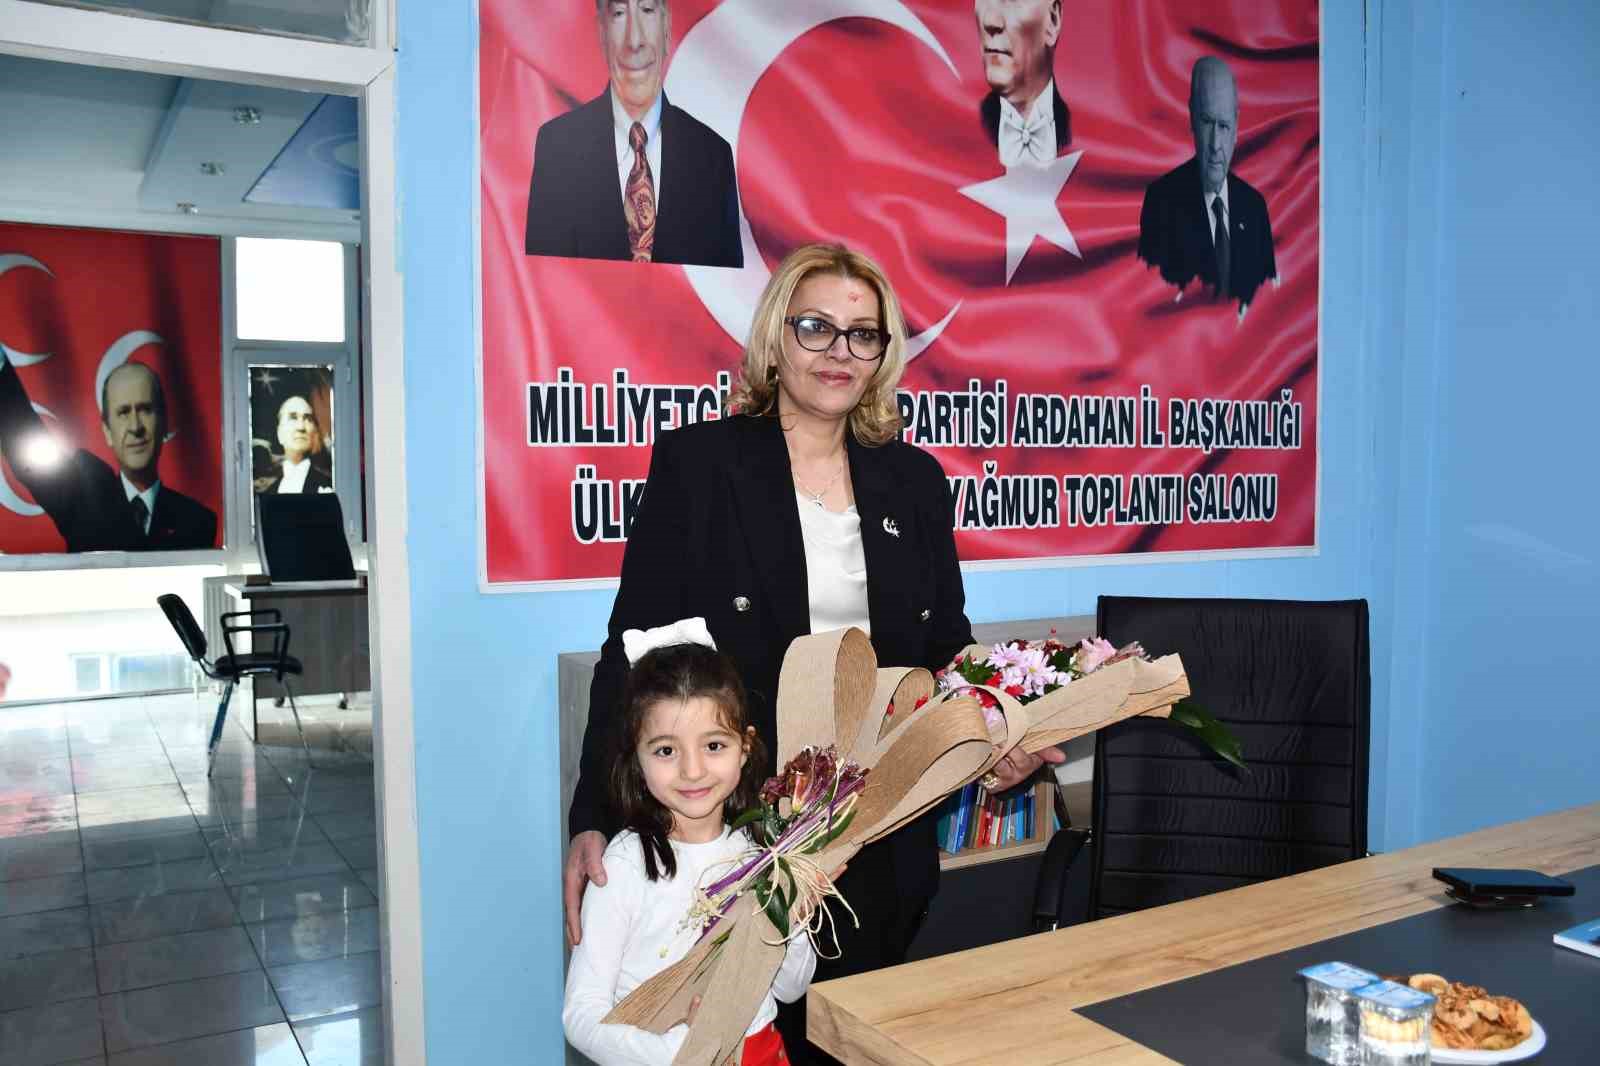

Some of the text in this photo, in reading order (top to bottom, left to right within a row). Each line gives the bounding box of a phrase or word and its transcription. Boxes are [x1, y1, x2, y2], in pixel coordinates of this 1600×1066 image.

[895, 381, 1006, 446] PARTİSİ
[1012, 394, 1135, 447] ARDAHAN
[1141, 386, 1164, 446] İL
[1170, 392, 1302, 453] BAŞKANLIĞI
[946, 462, 1058, 528] YAĞMUR
[1065, 475, 1184, 525] TOPLANTI
[1187, 474, 1277, 522] SALONU
